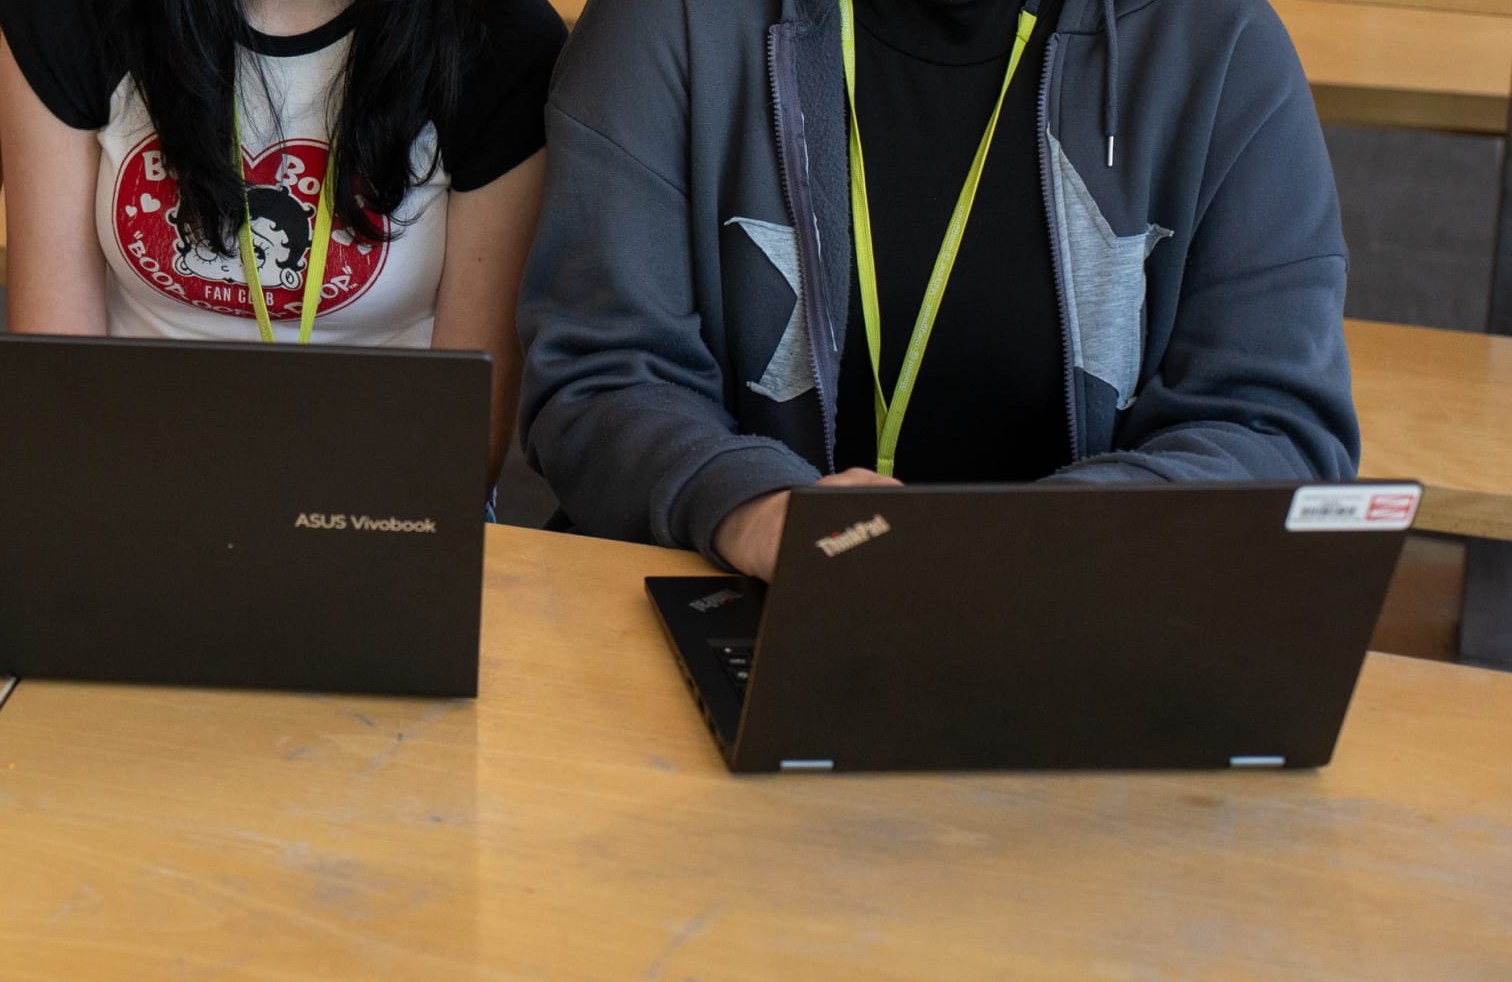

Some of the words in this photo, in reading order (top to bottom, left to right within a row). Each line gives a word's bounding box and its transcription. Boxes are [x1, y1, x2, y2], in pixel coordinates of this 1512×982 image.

[204, 285, 232, 303] FAN
[238, 288, 275, 306] CLB
[294, 512, 347, 530] ASUS
[350, 514, 437, 534] Vivobook
